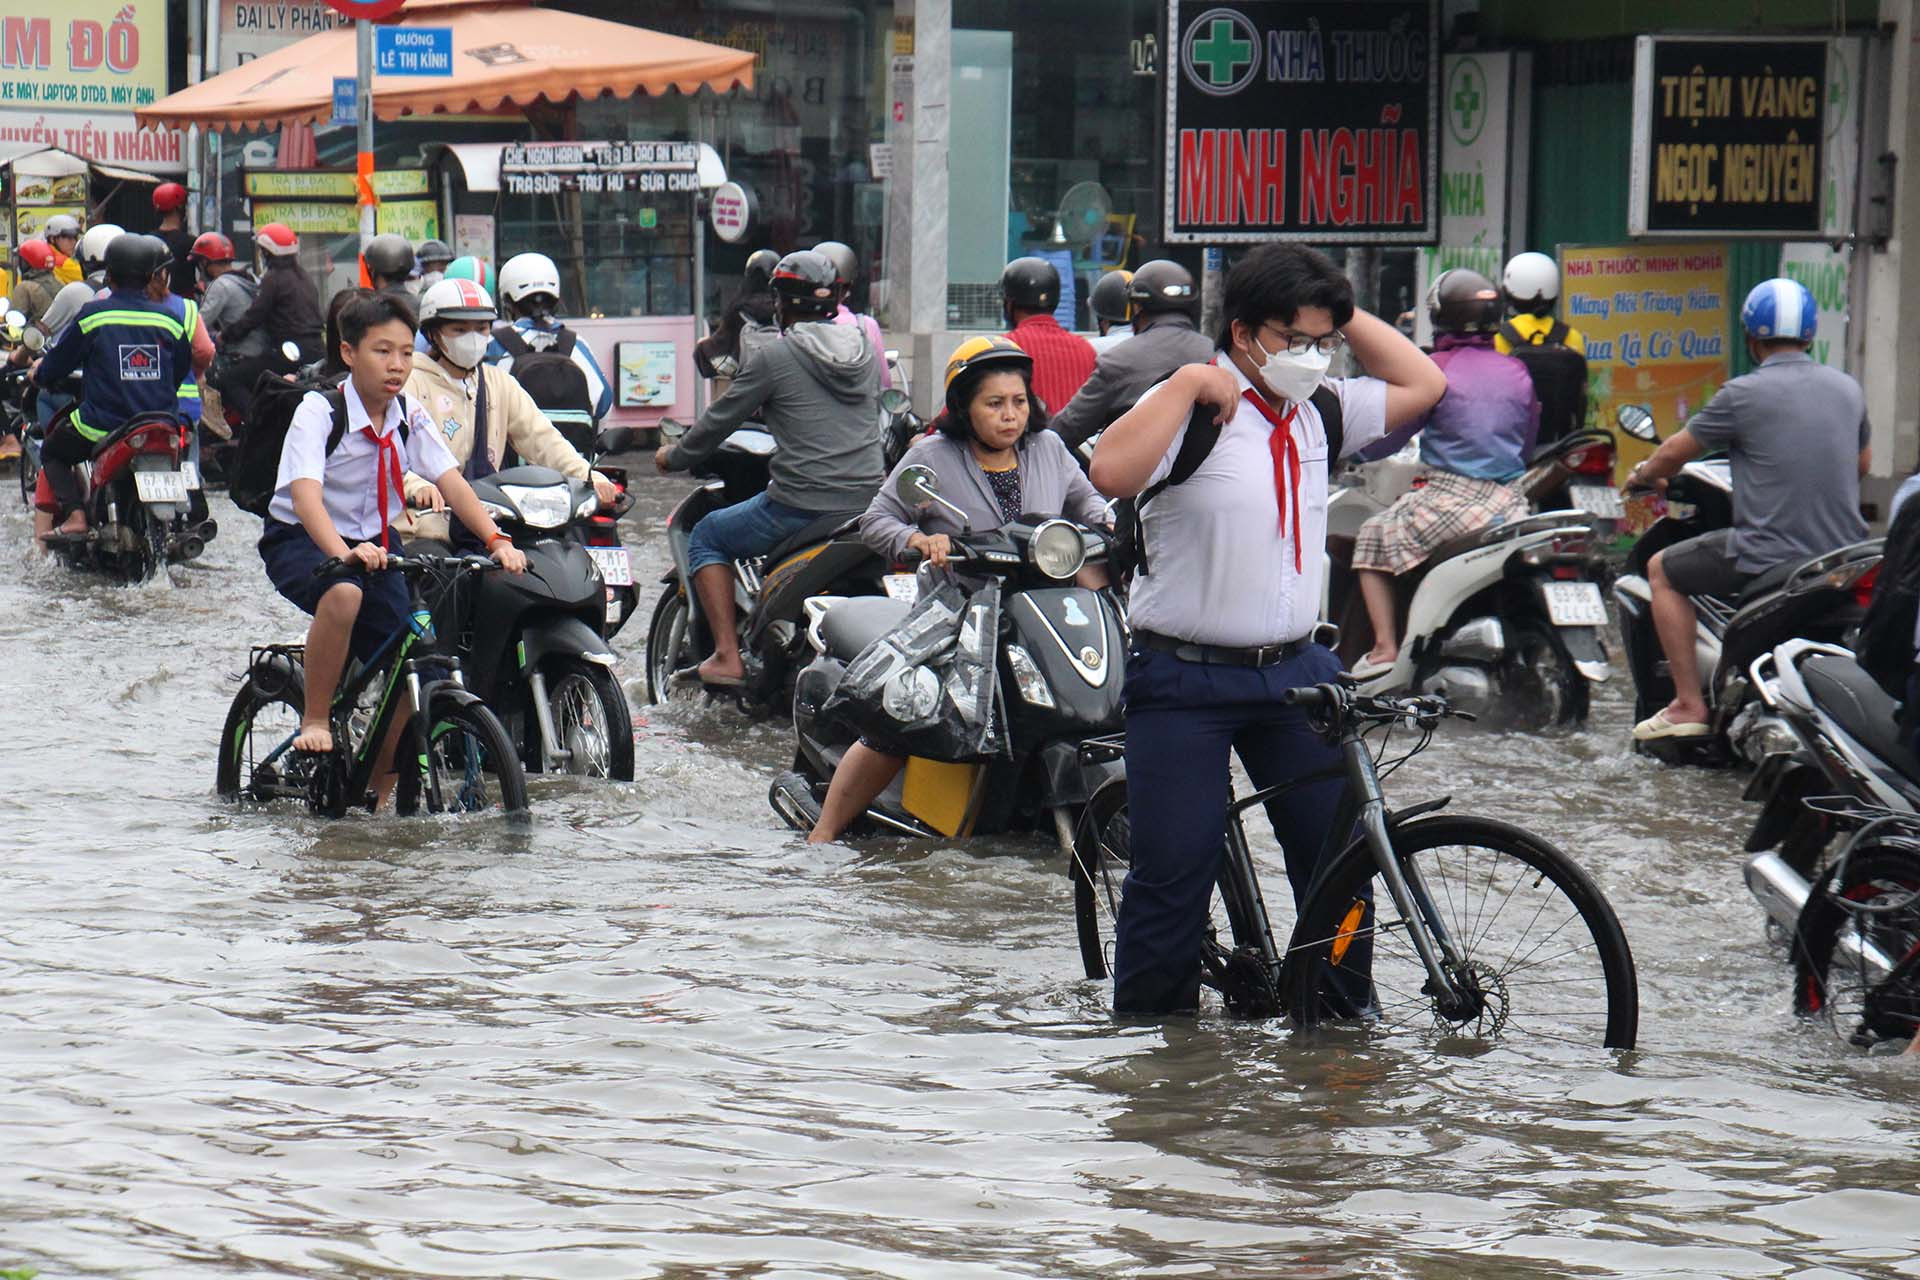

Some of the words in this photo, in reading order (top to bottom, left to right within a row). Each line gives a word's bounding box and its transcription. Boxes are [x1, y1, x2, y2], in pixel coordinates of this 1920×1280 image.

[236, 5, 262, 33] ĐẠI
[267, 1, 286, 29] LÝ
[0, 16, 51, 70] M
[395, 32, 434, 46] ĐƯỜNG
[1267, 16, 1325, 82] NHÀ
[381, 48, 396, 68] LÊ
[399, 51, 418, 72] THỊ
[2, 80, 14, 99] XE
[1660, 65, 1732, 127] TIỆM
[1741, 65, 1817, 118] VÀNG
[113, 129, 181, 162] NHANH
[1178, 128, 1287, 226] MINH
[1299, 103, 1424, 226] NGHĨA
[1656, 142, 1719, 216] NGỌC
[1722, 128, 1817, 203] NGUYÊN
[1442, 160, 1485, 216] NHÀ
[1645, 257, 1680, 273] MINH
[1583, 334, 1613, 360] ua
